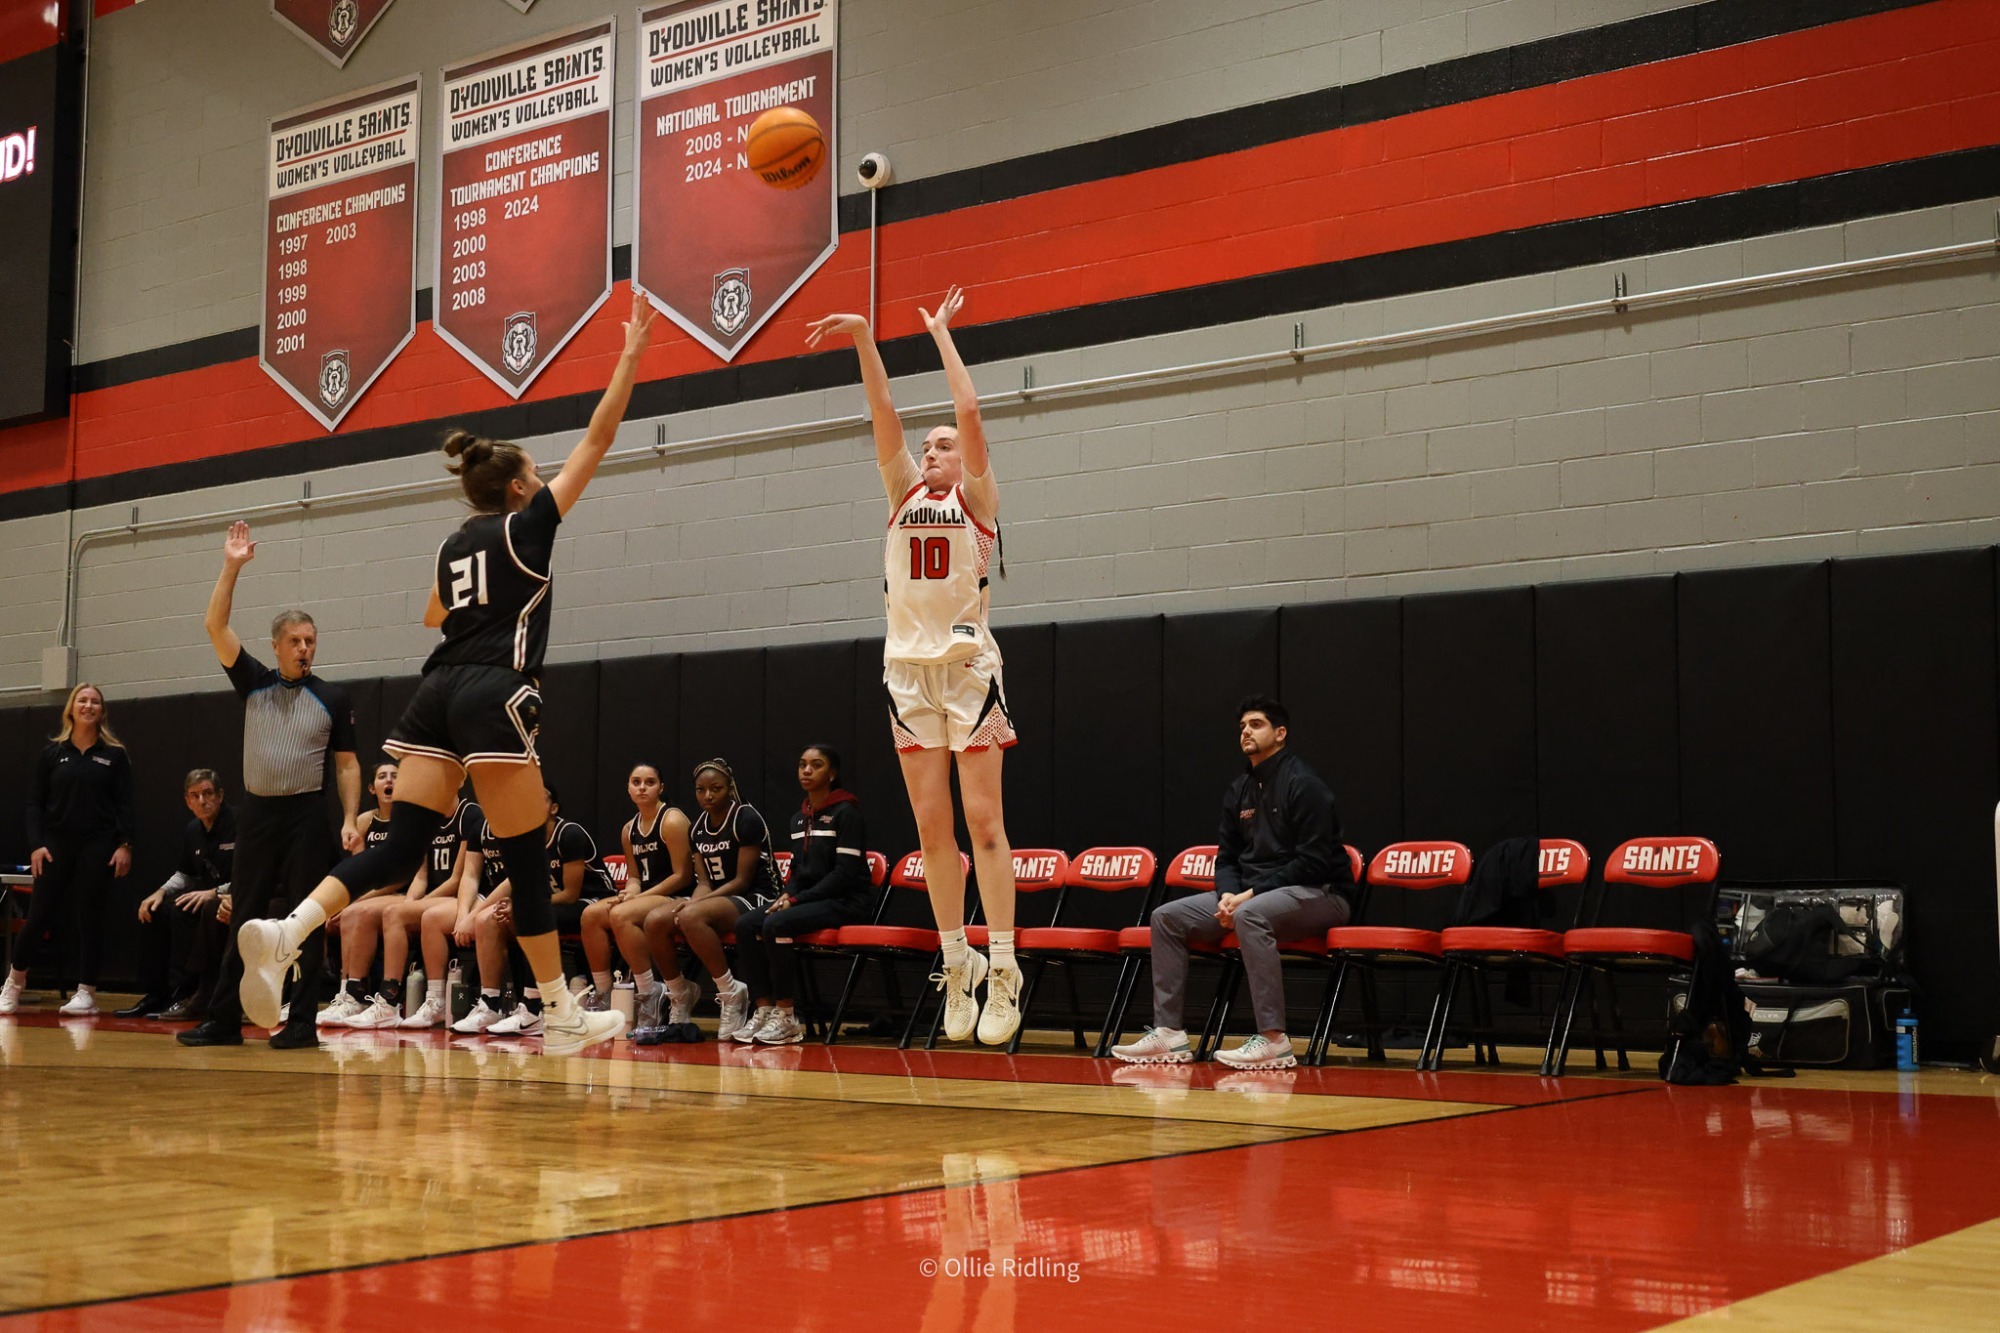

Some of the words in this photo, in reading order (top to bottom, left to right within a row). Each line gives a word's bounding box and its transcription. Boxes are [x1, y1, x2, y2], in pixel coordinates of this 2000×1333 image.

[650, 51, 718, 88] WOMEN'S
[725, 23, 820, 68] VOLLEYBALL
[451, 109, 510, 142] WOMEN'S
[516, 85, 598, 124] VOLLEYBALL
[656, 102, 720, 138] NATIONAL
[724, 76, 817, 119] TOURNAMENT
[0, 126, 37, 183] D!
[485, 134, 562, 173] CONFERENCE
[685, 131, 722, 157] 2008
[277, 159, 329, 189] WOMEN'S
[333, 139, 406, 174] VOLLEYBALL
[450, 170, 526, 208] TOURNAMENT
[530, 151, 600, 188] CHAMPIONS
[685, 156, 722, 183] 2024
[276, 200, 342, 233] CONFERENCE
[345, 183, 406, 216] CHAMPIONS
[453, 207, 486, 232] 1998
[504, 194, 539, 220] 2024
[278, 234, 309, 255] 1997
[326, 222, 357, 244] 2003
[452, 234, 486, 258] 2000
[278, 259, 308, 280] 1998
[452, 260, 486, 285] 2003
[277, 283, 307, 305] 1999
[452, 287, 486, 311] 2008
[276, 308, 307, 330] 2000
[276, 333, 305, 355] 2001
[909, 536, 950, 580] 10
[449, 550, 489, 611] 21
[434, 847, 450, 871] 10
[704, 856, 726, 881] 13
